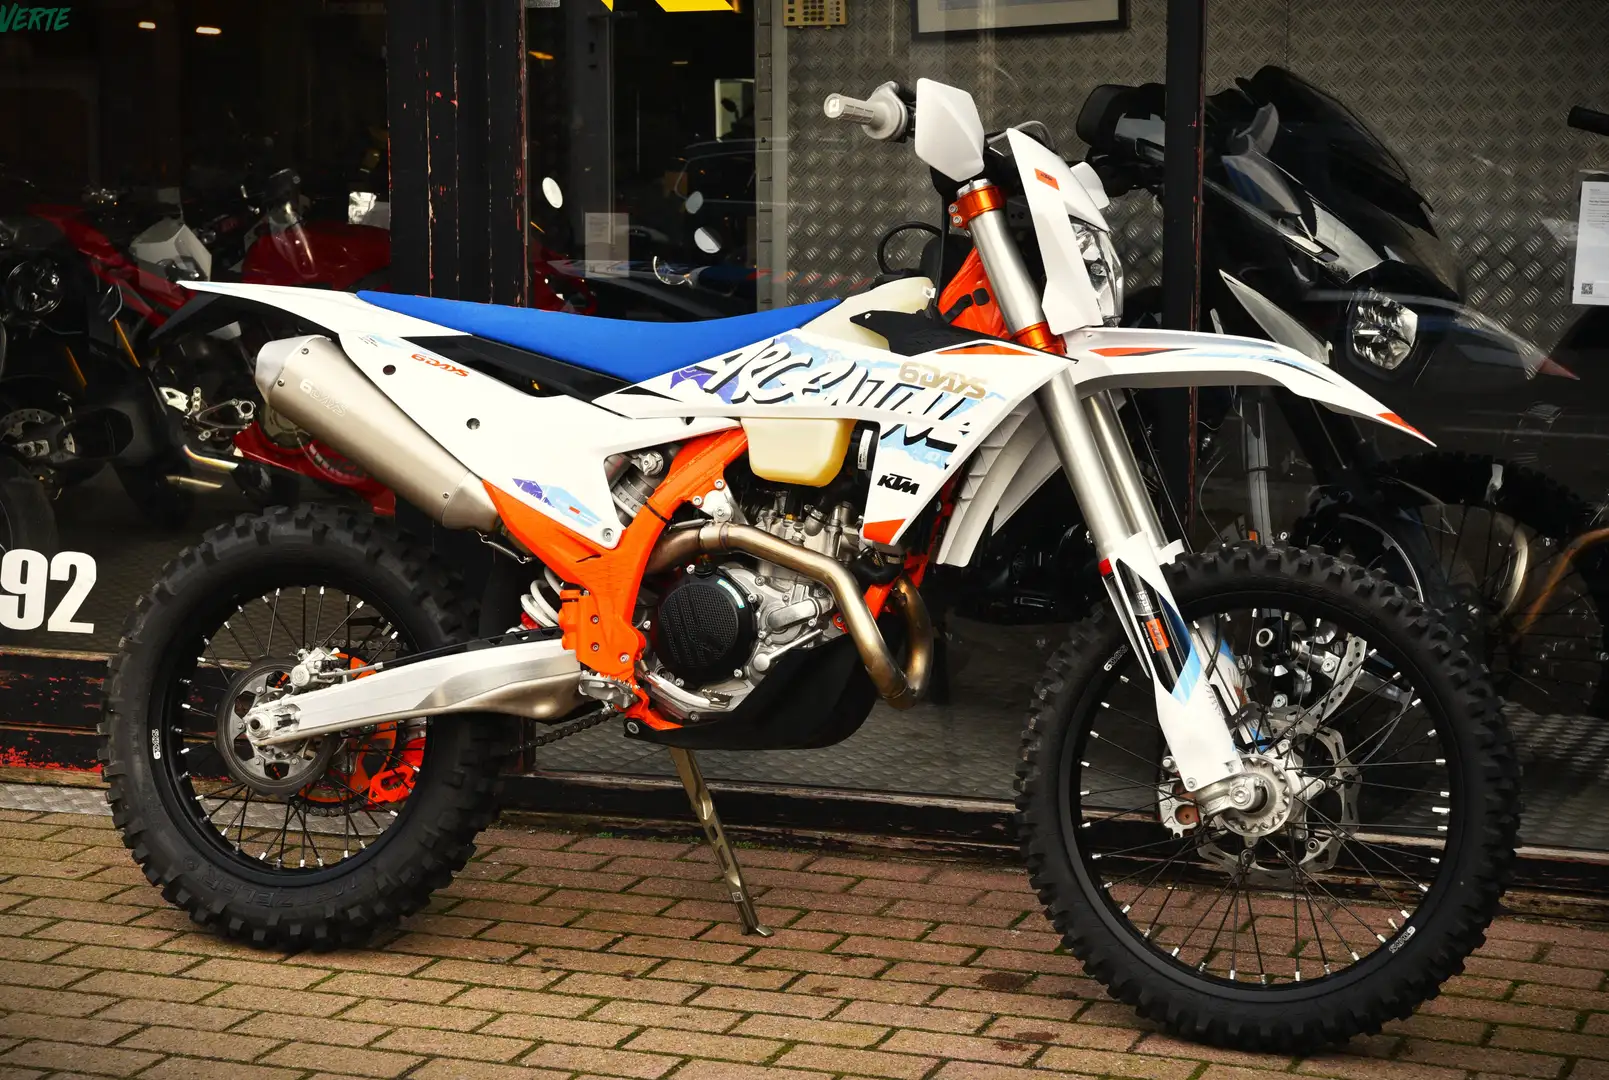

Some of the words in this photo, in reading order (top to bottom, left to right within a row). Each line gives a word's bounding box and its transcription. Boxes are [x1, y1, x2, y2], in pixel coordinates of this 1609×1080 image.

[0, 3, 71, 32] VERTE
[411, 353, 470, 377] 6DAYS
[899, 361, 987, 399] 6DAYS
[877, 473, 920, 495] KTM
[0, 548, 97, 634] 92
